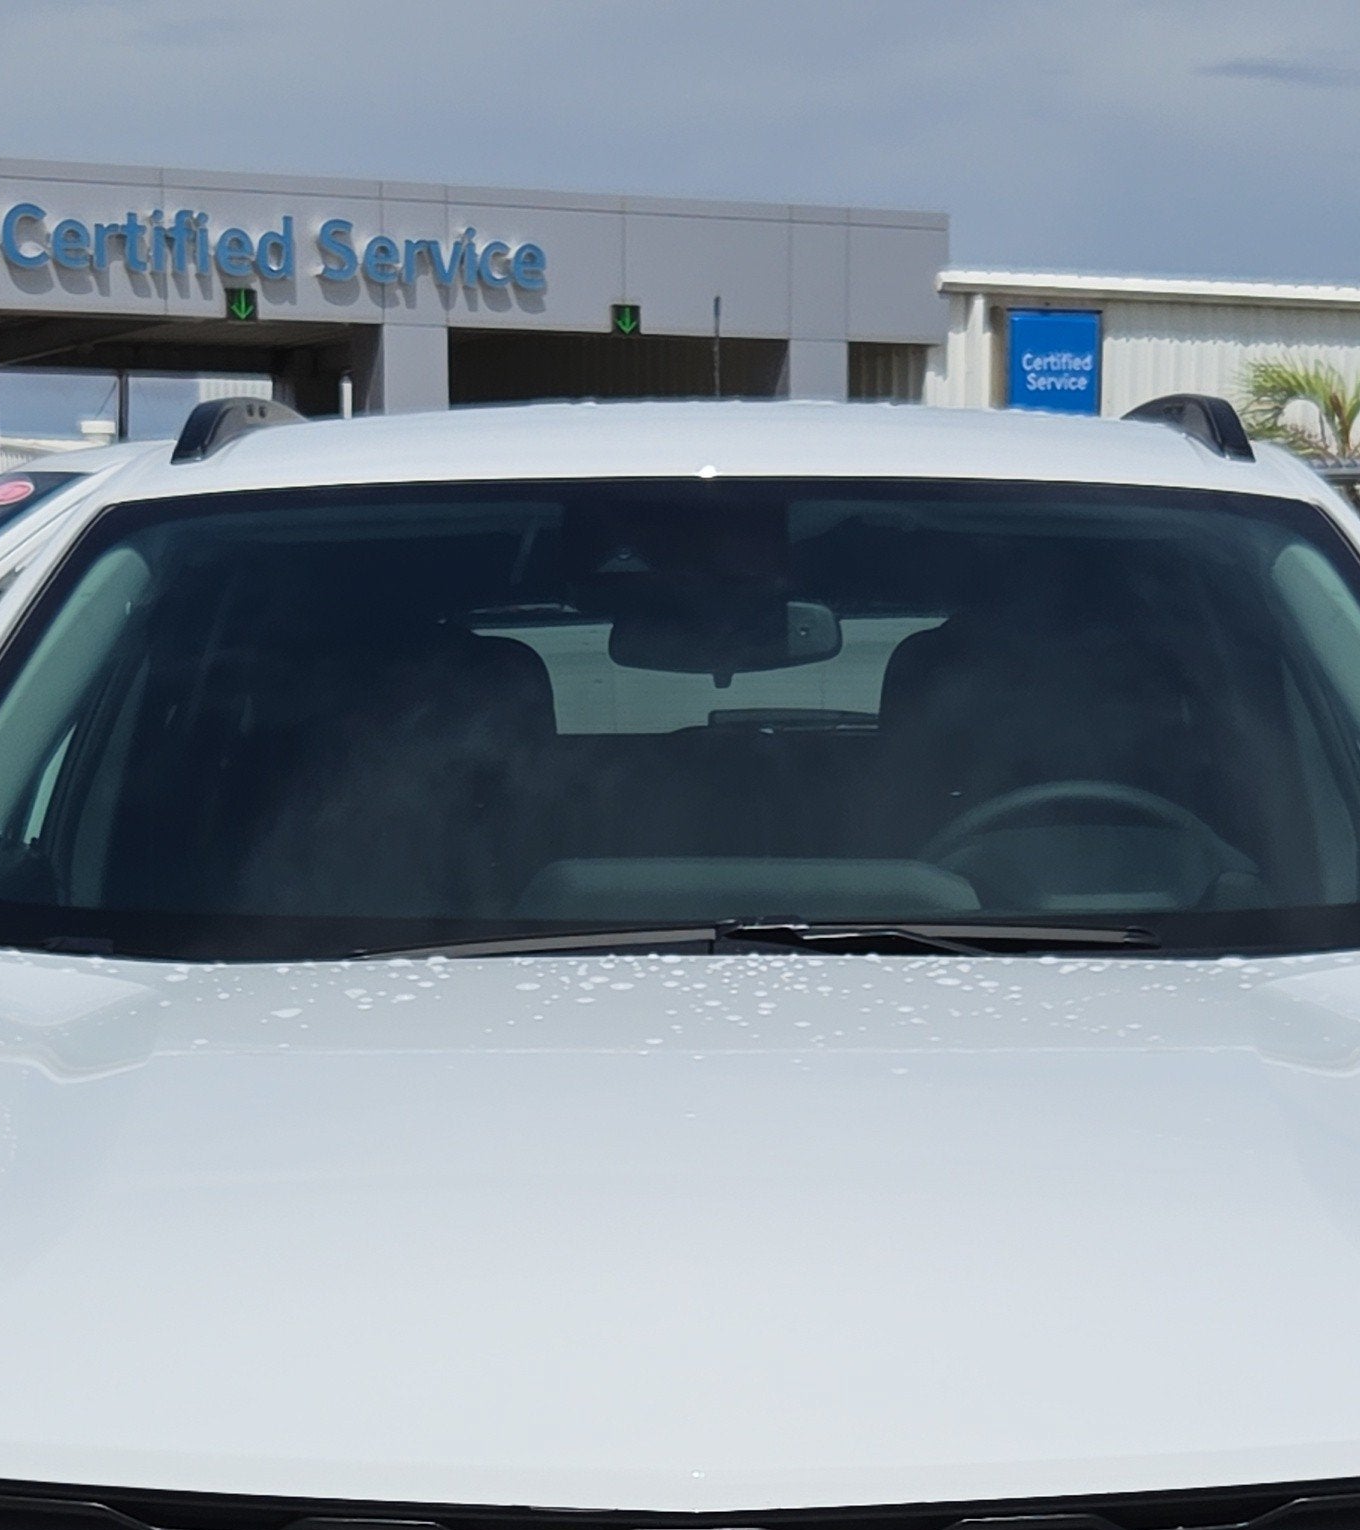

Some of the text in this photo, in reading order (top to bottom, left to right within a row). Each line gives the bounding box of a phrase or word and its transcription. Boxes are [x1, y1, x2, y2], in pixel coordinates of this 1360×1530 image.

[1, 202, 548, 292] Certified Service
[1022, 352, 1093, 371] Certified
[1027, 373, 1087, 390] Service
